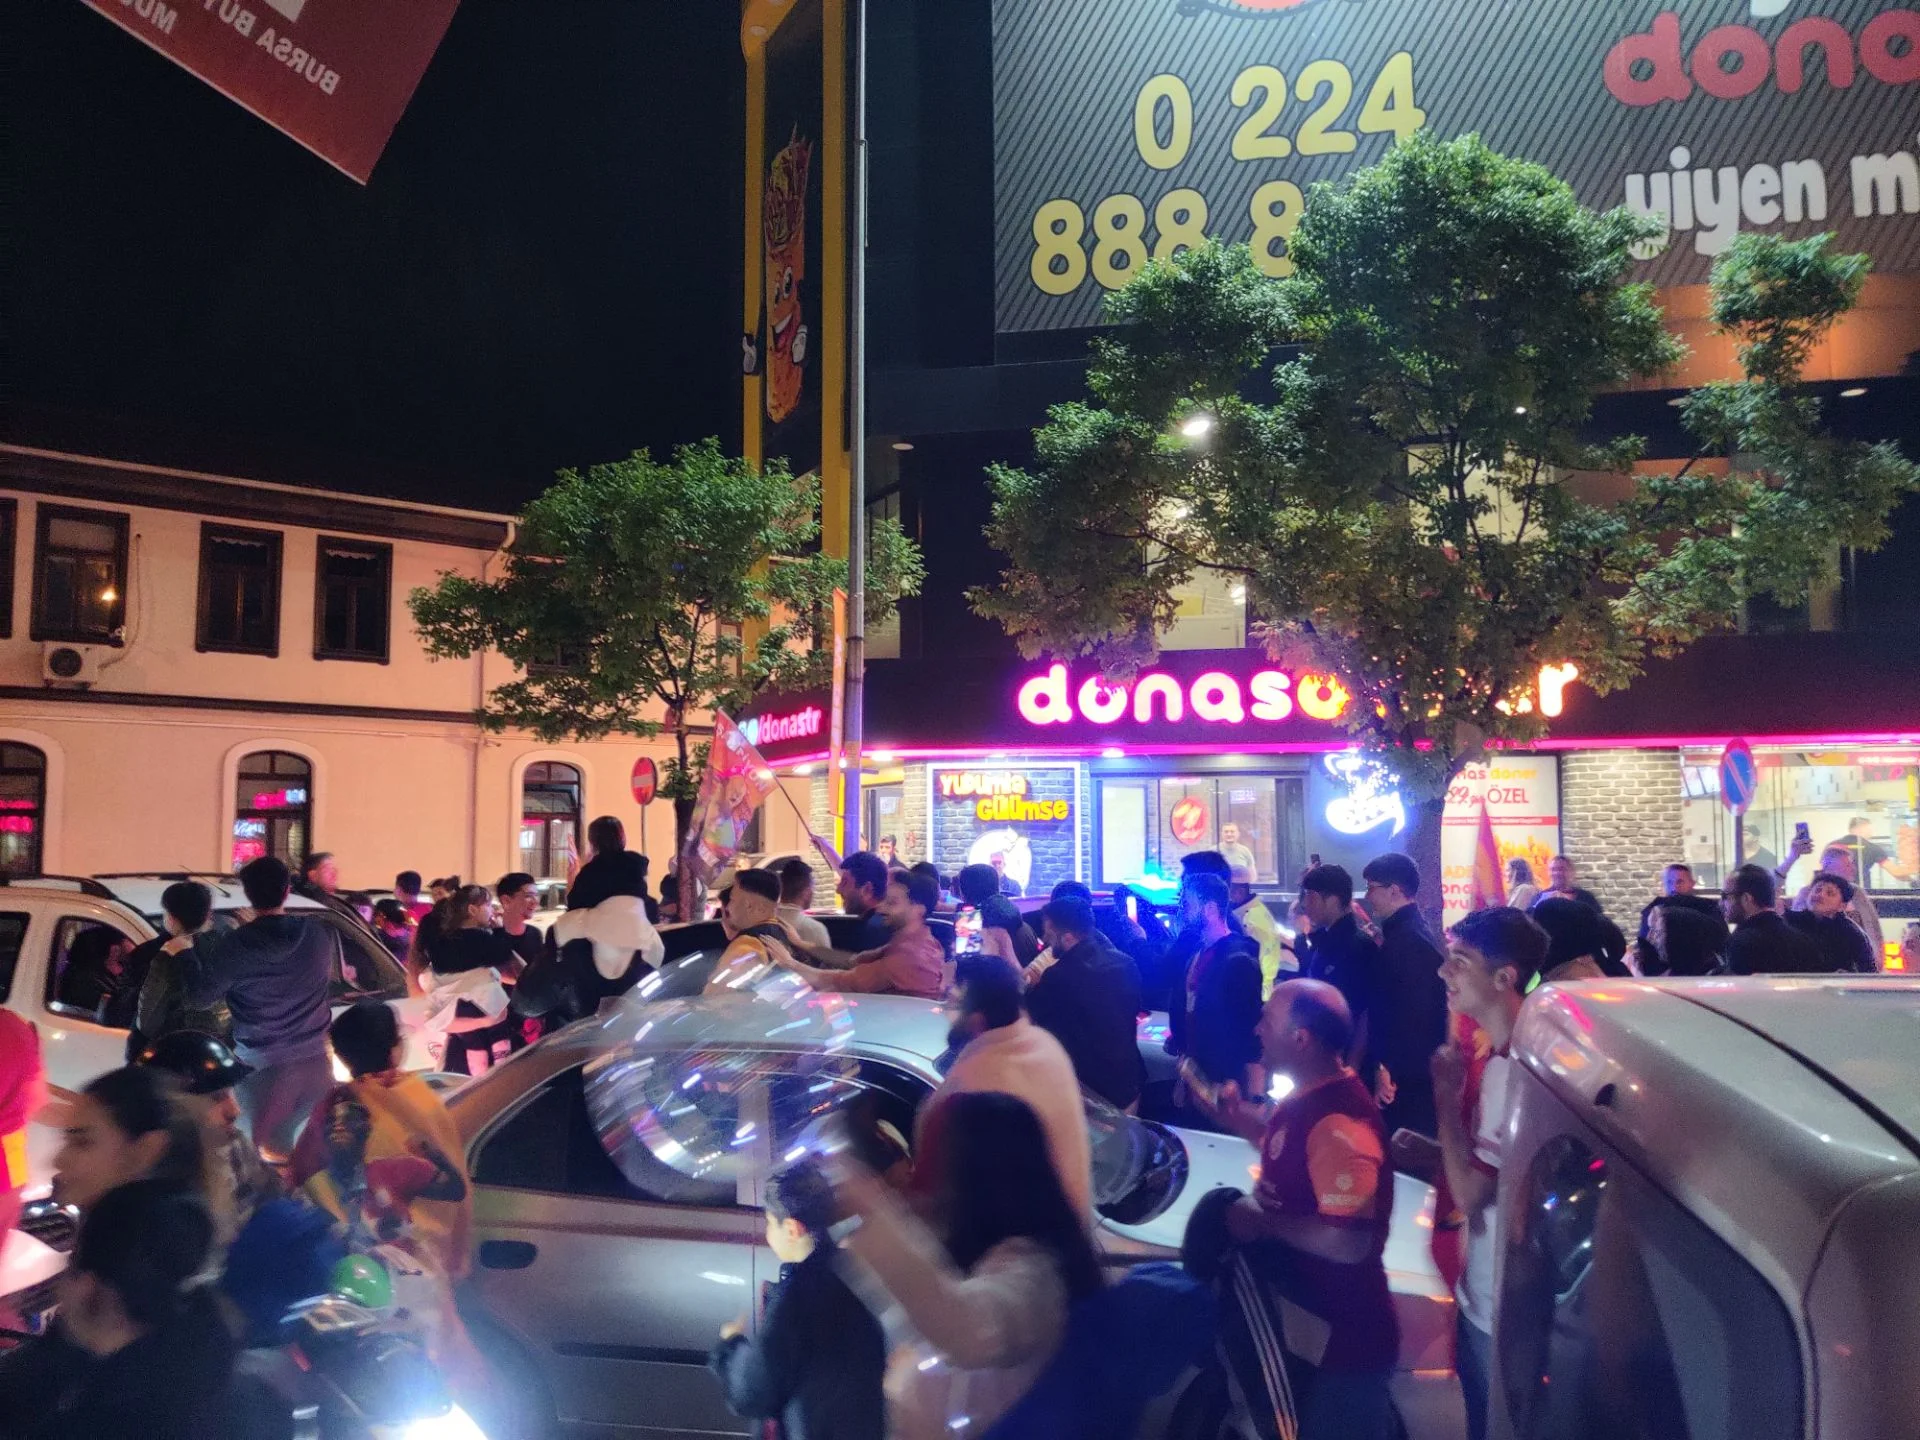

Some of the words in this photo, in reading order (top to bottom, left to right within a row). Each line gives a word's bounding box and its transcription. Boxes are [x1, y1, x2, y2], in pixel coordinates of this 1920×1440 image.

[1134, 73, 1194, 171] 0
[1230, 50, 1427, 162] 224
[1625, 145, 1828, 260] yiyen
[1851, 150, 1920, 218] m
[1487, 784, 1530, 804] ÖZEL
